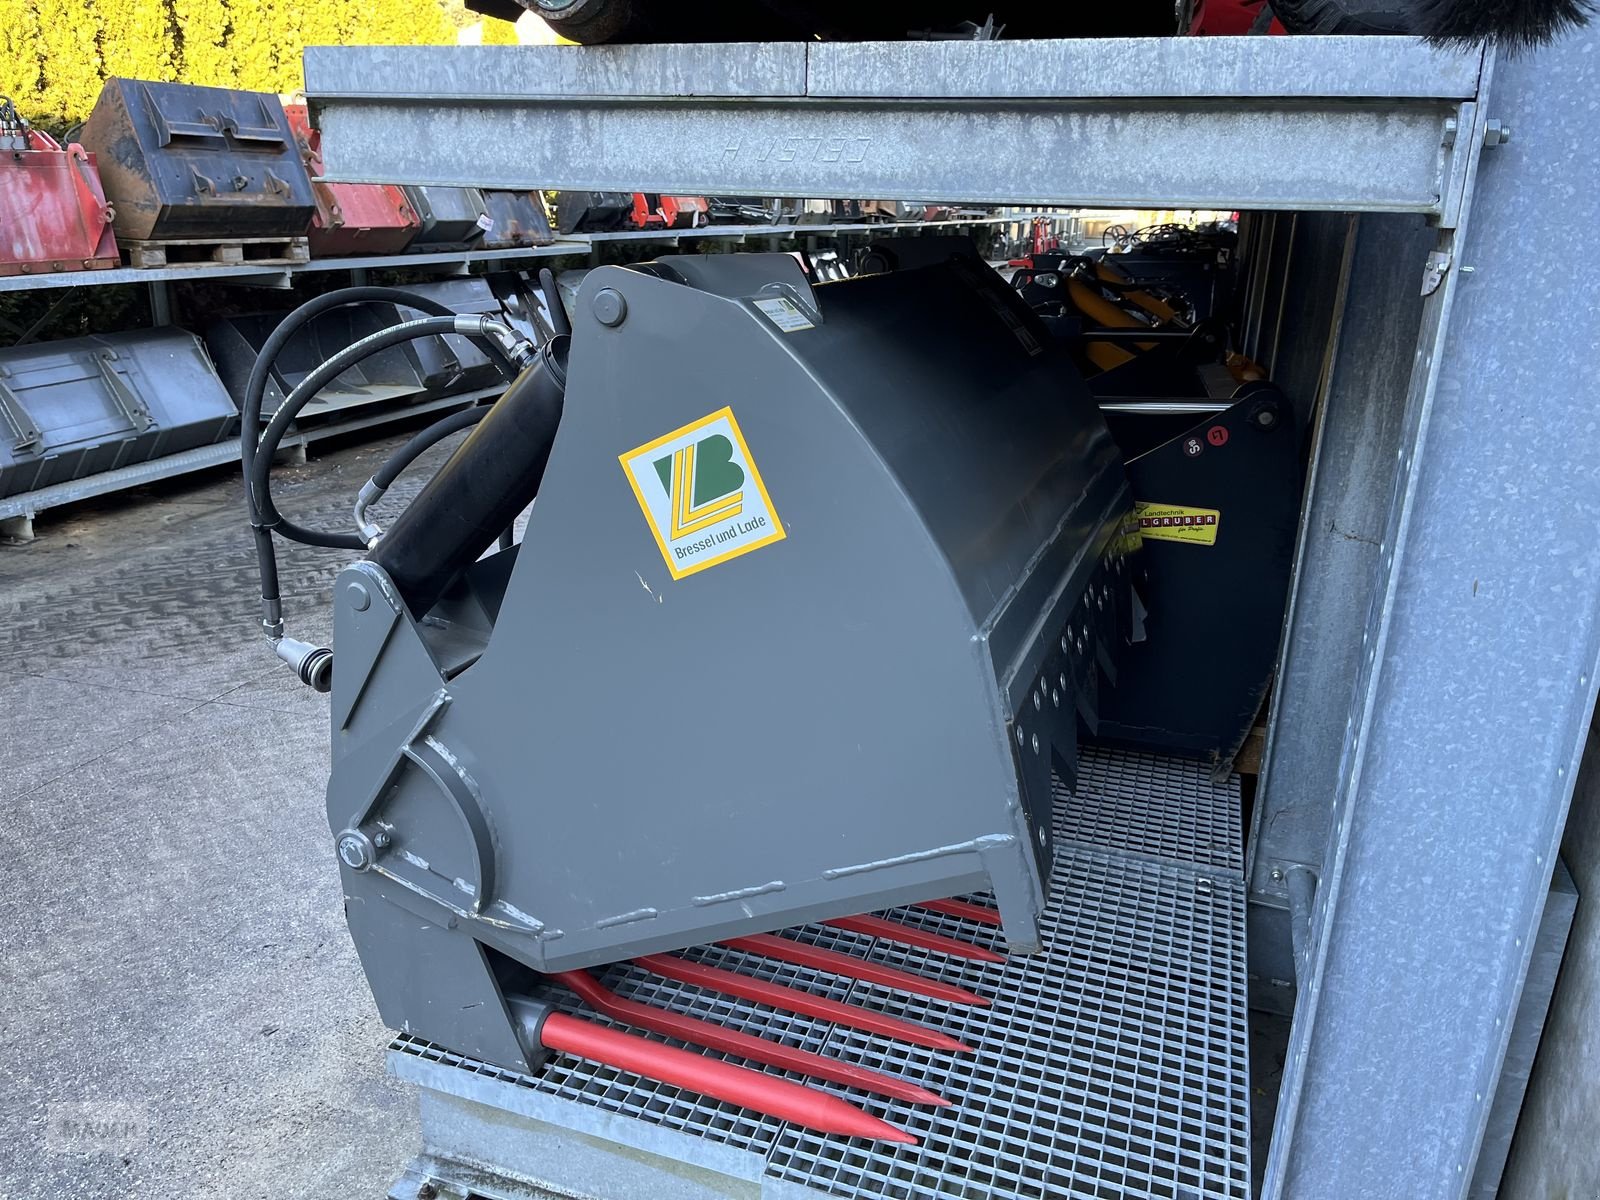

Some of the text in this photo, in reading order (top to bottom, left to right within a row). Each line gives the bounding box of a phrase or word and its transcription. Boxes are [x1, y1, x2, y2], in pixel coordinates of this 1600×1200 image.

[674, 516, 767, 560] Bressel und Lade
